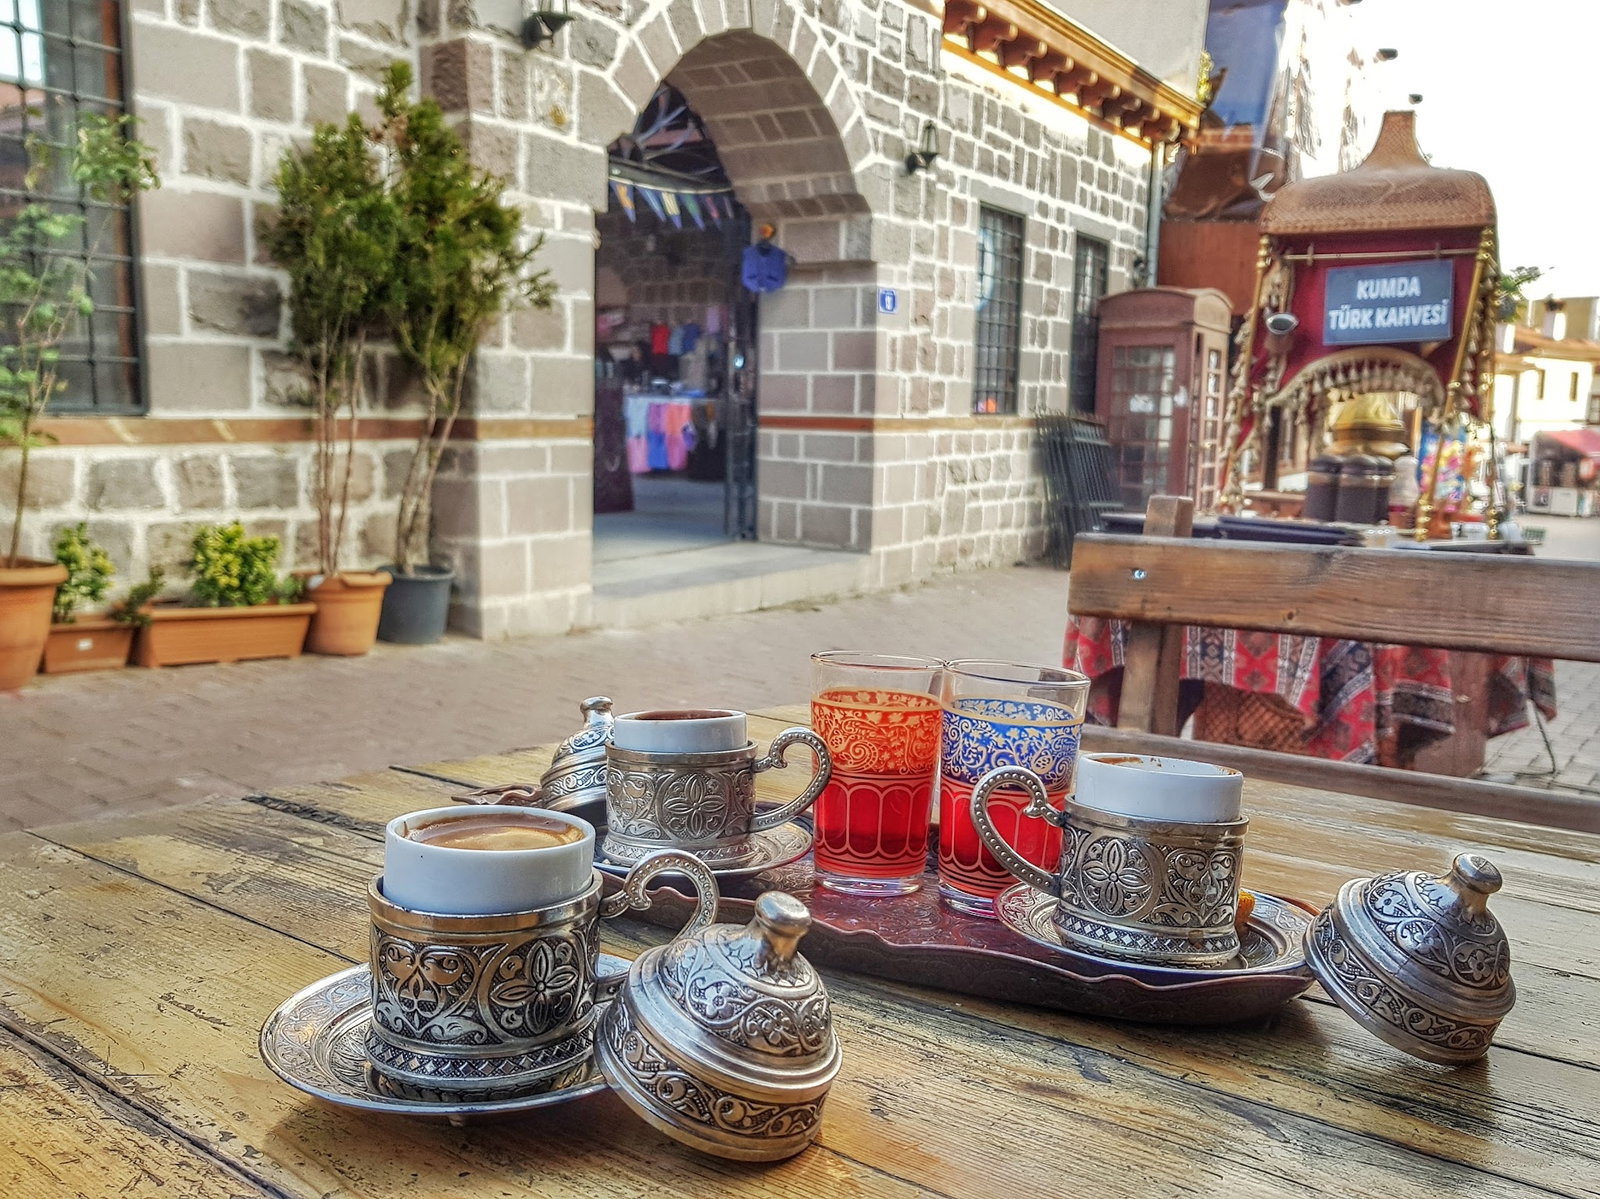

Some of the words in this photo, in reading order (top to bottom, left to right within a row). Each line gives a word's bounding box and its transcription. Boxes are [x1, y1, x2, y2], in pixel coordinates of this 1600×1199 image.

[1356, 276, 1420, 299] KUMDA
[1329, 304, 1373, 330] TÜRK
[1375, 300, 1449, 328] KAHVESİ
